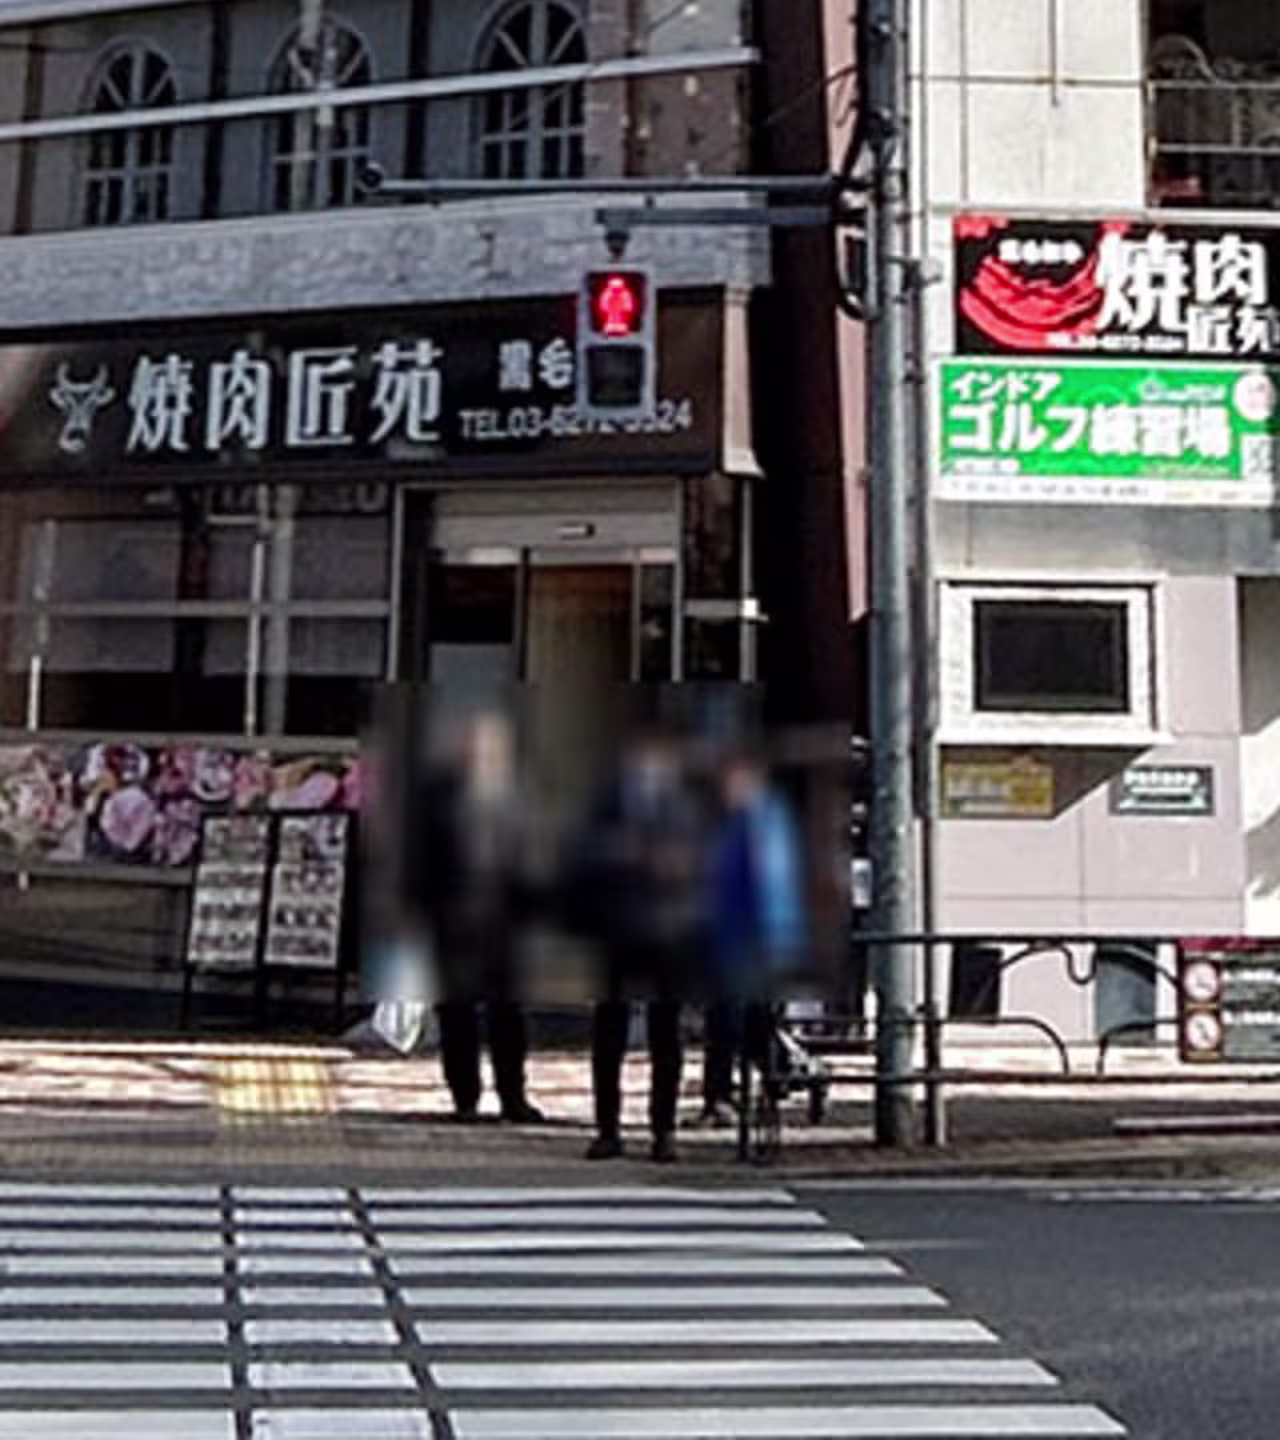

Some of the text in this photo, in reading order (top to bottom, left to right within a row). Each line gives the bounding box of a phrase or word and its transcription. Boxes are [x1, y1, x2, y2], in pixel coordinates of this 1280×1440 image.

[1094, 230, 1268, 331] 焼肉
[125, 338, 444, 454] 焼肉匠苑
